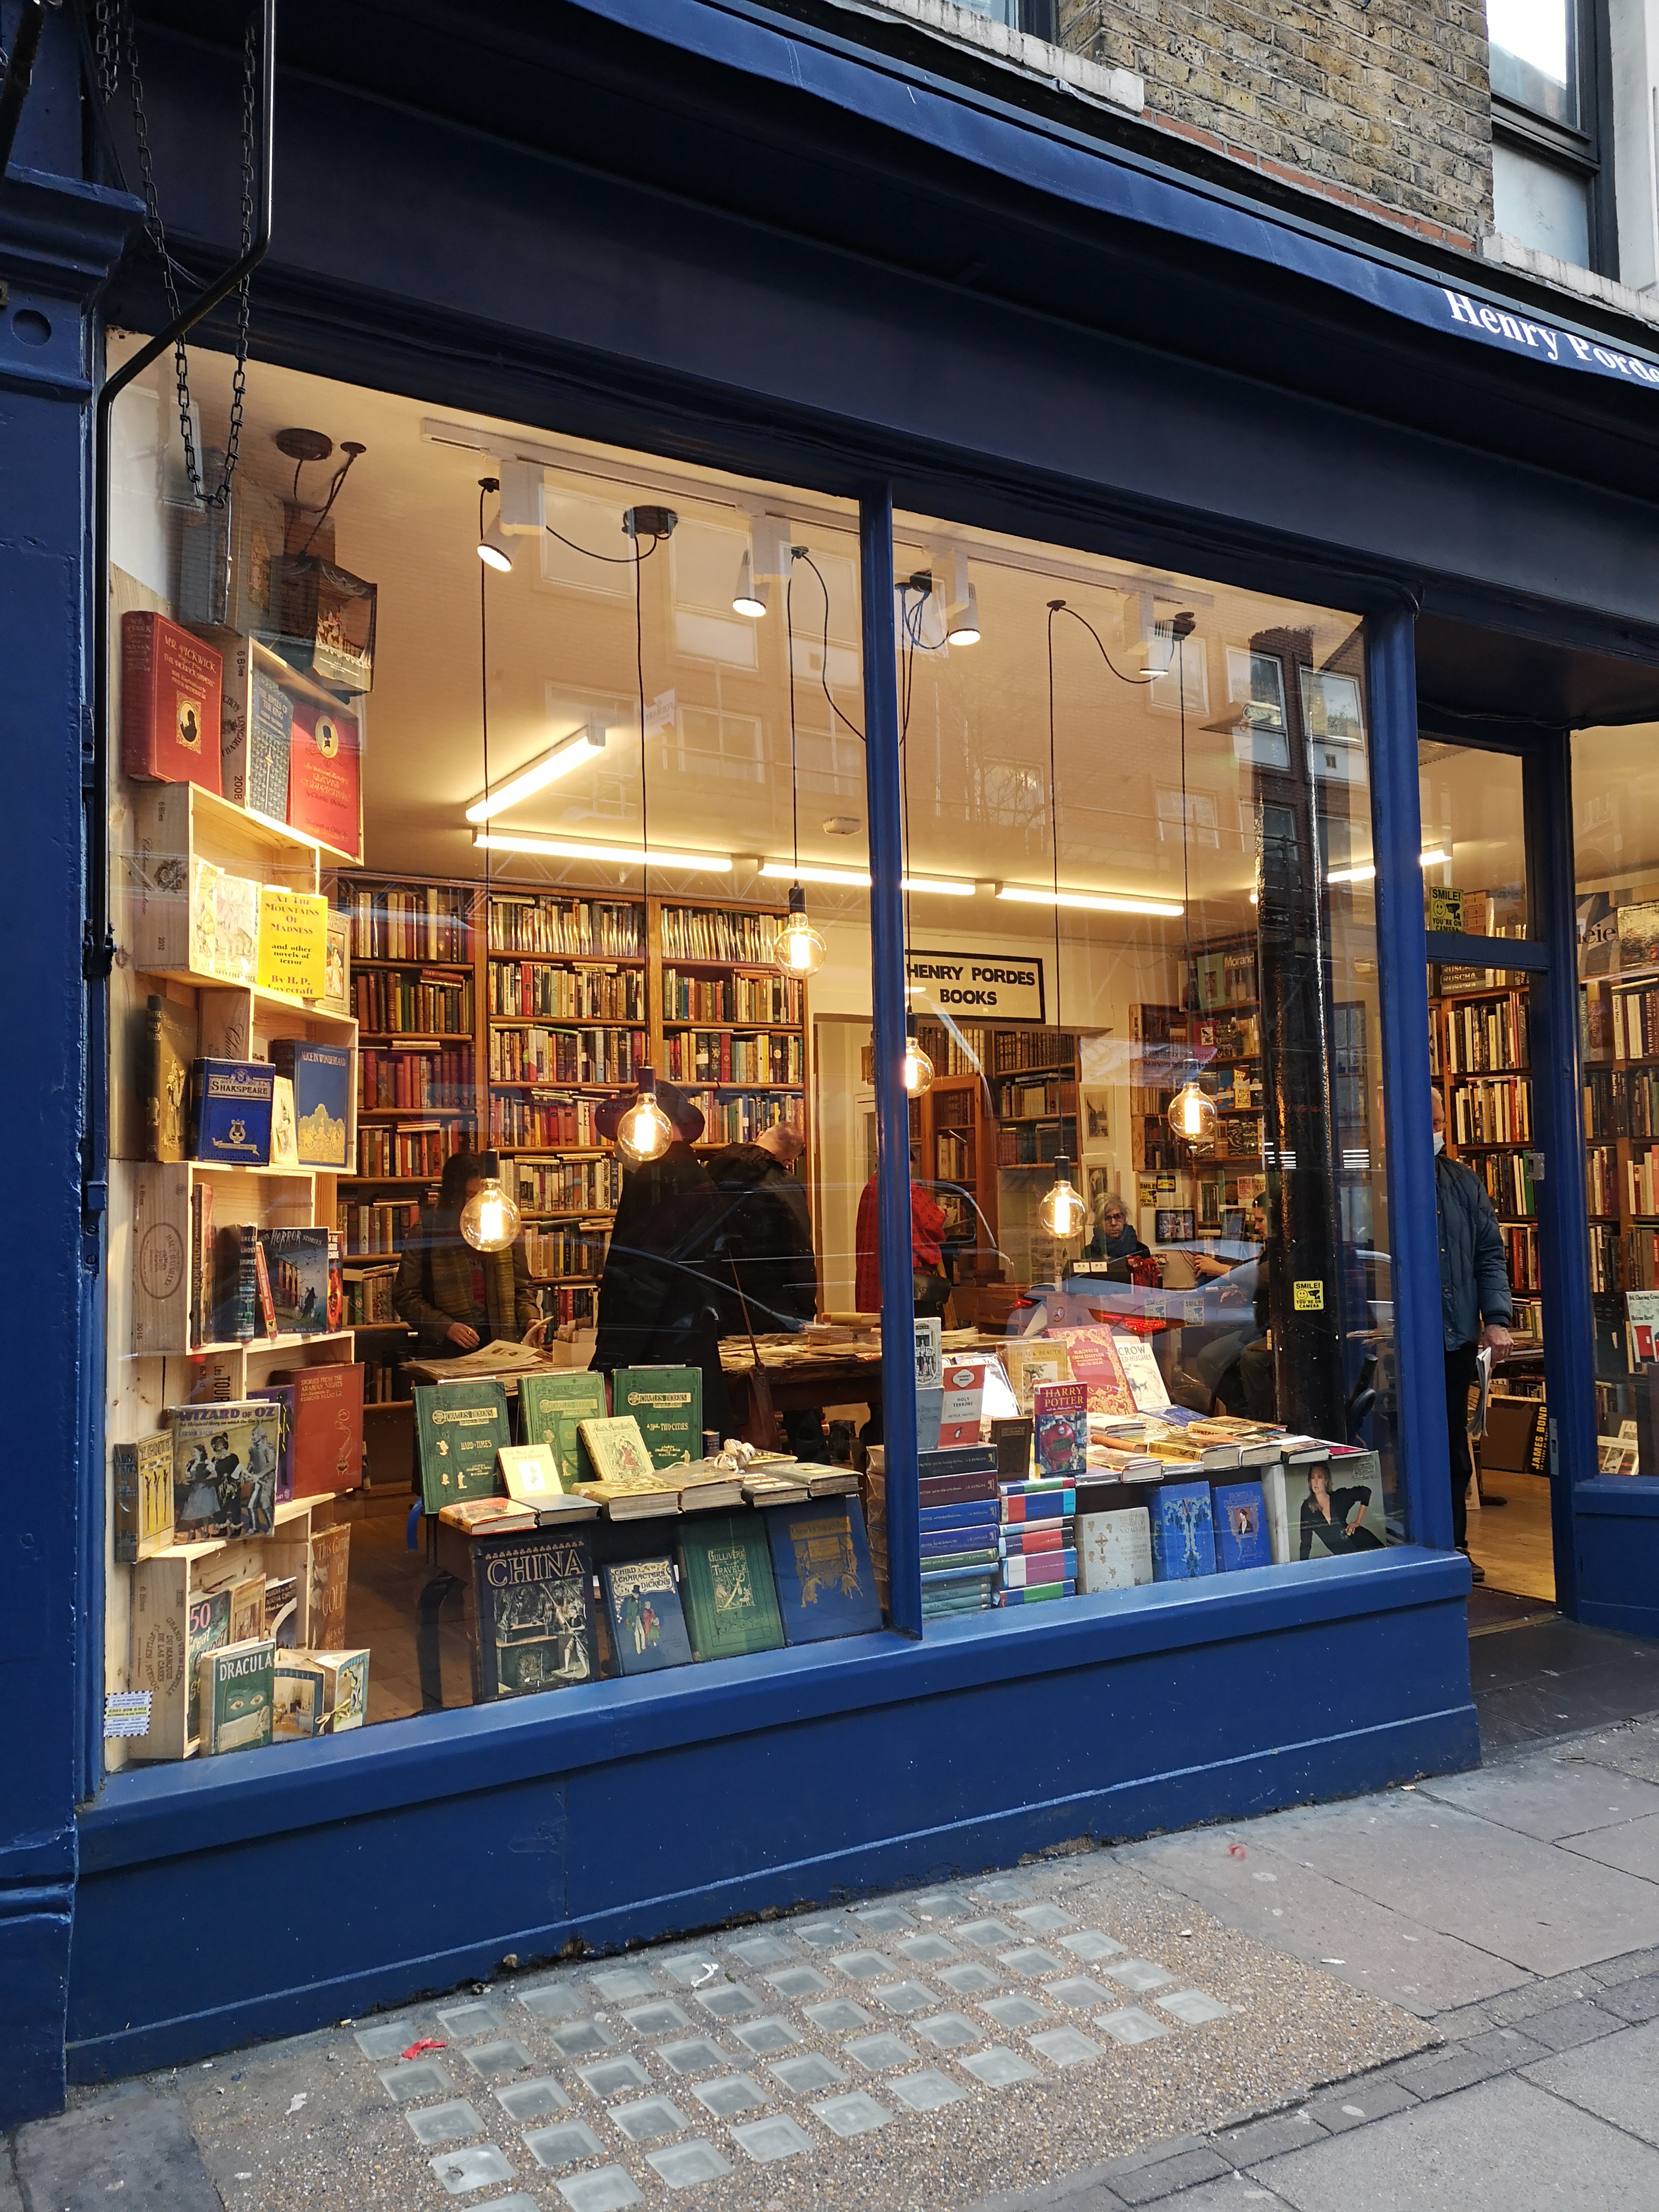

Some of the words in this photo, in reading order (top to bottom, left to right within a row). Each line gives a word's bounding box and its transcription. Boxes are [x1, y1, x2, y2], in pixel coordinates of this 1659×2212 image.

[1441, 289, 1557, 361] Henry
[234, 775, 243, 800] 2008
[1432, 888, 1461, 902] SMILE!
[1433, 917, 1451, 927] YOU'RE
[1452, 919, 1462, 927] ON
[290, 944, 311, 953] other
[271, 975, 286, 984] By
[300, 977, 311, 985] P.
[906, 963, 964, 980] HENRY
[972, 967, 1036, 986] PORDES
[1443, 972, 1477, 982] RUSCHA
[940, 988, 997, 1005] BOOKS
[301, 1051, 314, 1062] ALICE
[314, 1053, 319, 1062] IN
[319, 1054, 346, 1067] WONDERLAND
[211, 1081, 268, 1095] SHAKSPEARE
[270, 1229, 302, 1251] HORROR
[302, 1234, 323, 1246] STORIES
[1118, 1345, 1145, 1356] CROW
[214, 1366, 225, 1376] Les
[1045, 1386, 1084, 1398] HARRY
[1044, 1395, 1084, 1408] POTTER
[179, 1408, 240, 1421] WIZARD
[254, 1407, 276, 1417] OZ
[1536, 1406, 1548, 1433] BOND
[460, 1442, 474, 1450] HARD
[475, 1440, 493, 1449] TIMES
[1531, 1435, 1544, 1469] JAMES
[318, 1542, 331, 1560] This
[487, 1549, 585, 1587] CHINA
[614, 1567, 636, 1576] CHILD
[712, 1563, 746, 1576] TRAVELS
[618, 1570, 665, 1583] CHARACTERS
[641, 1579, 670, 1589] DICKENS
[322, 1581, 346, 1617] GOLF
[190, 1603, 211, 1634] 50
[219, 1652, 272, 1681] DRACULA
